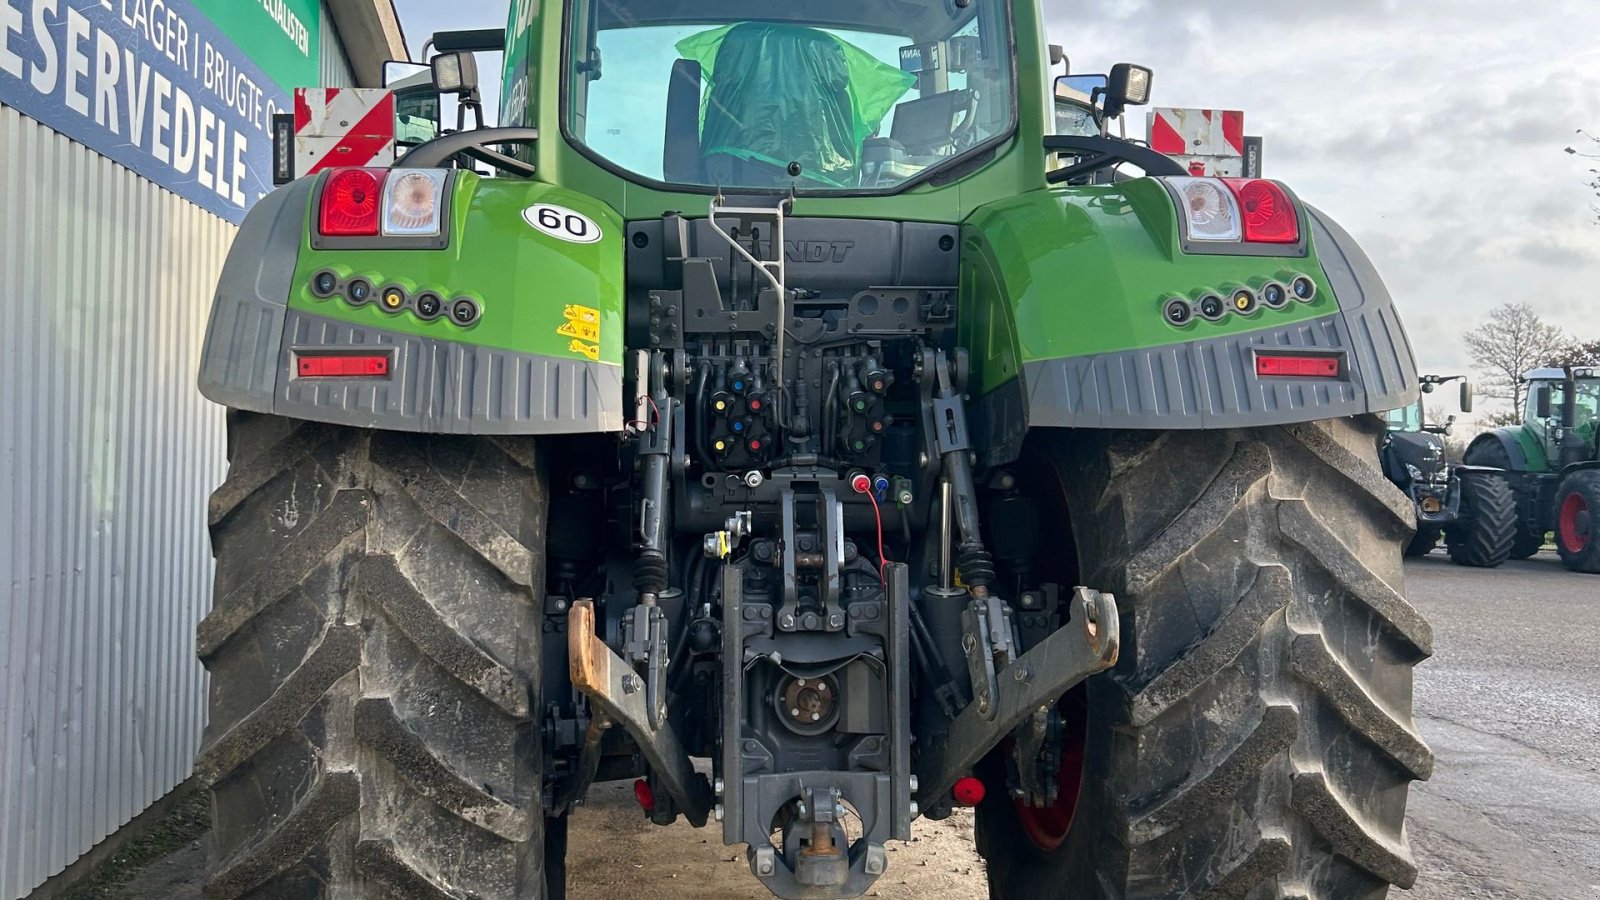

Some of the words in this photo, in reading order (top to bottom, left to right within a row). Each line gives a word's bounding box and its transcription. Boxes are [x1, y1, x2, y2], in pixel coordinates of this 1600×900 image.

[0, 0, 247, 208] ESERVEDELE
[204, 41, 263, 130] BRUGTE
[266, 98, 285, 139] O
[538, 208, 587, 237] 60
